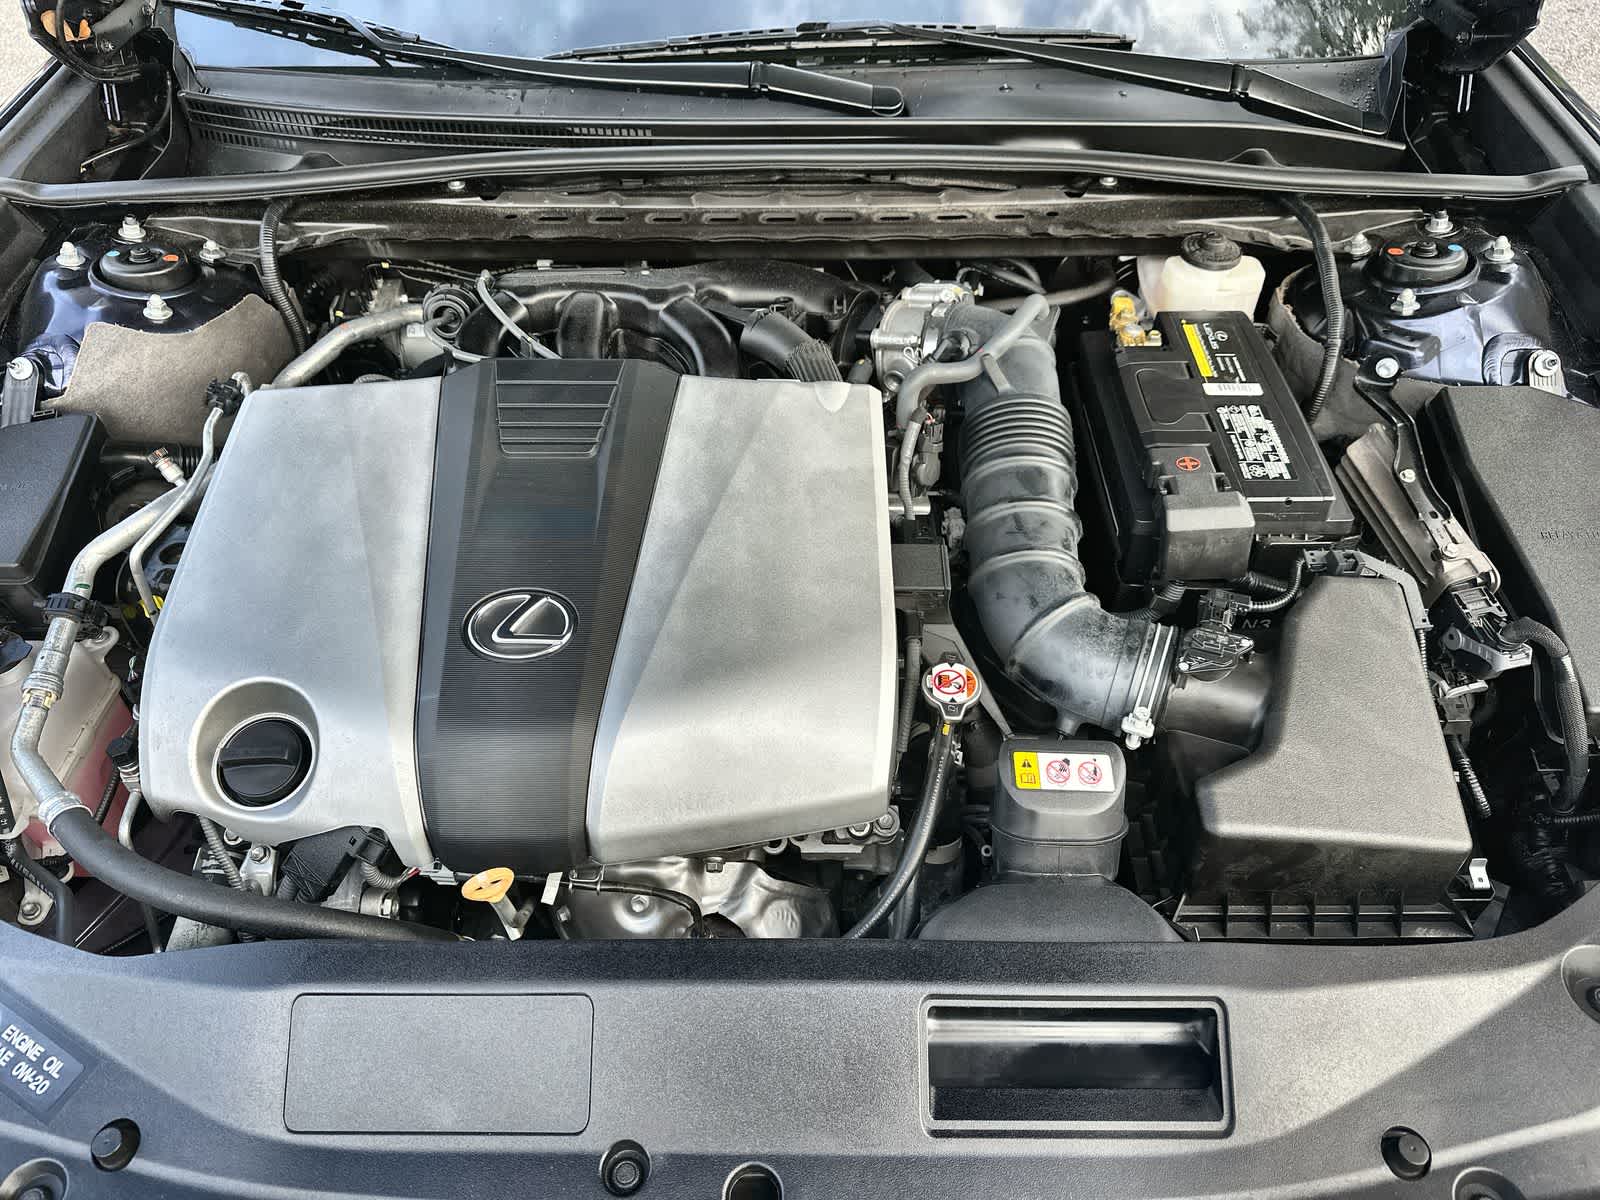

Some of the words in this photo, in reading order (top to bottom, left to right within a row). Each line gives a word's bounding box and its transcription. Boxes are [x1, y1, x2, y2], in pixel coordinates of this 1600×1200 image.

[1202, 322, 1219, 350] LEXUS
[0, 1042, 15, 1067] AE
[11, 1061, 50, 1095] 0W-20
[1, 1024, 46, 1062] ENGINE
[42, 1056, 64, 1079] OIL
